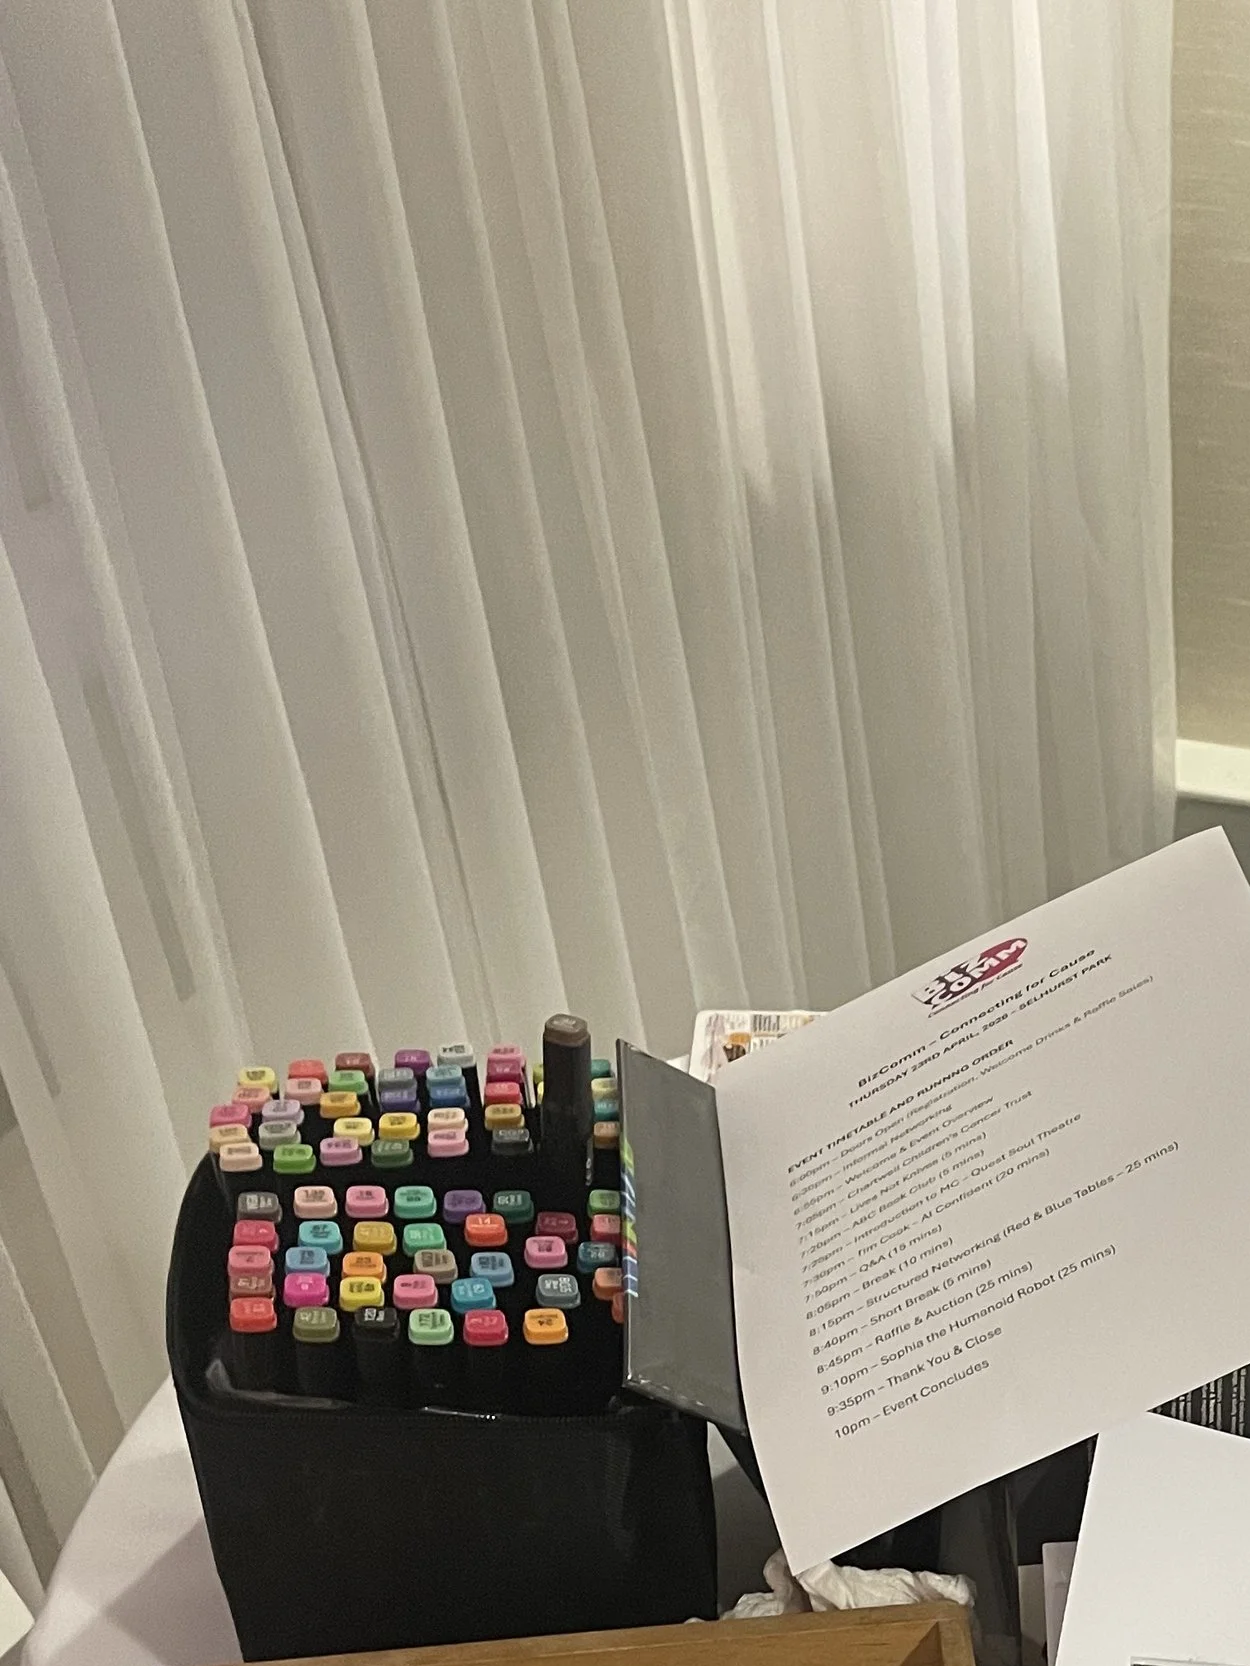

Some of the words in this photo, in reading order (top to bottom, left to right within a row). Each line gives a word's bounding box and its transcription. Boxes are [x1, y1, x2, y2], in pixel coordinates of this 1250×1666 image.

[857, 1044, 926, 1088] BizComm
[938, 989, 1023, 1040] Connecting
[1024, 976, 1045, 992] for
[1048, 949, 1095, 978] Cause
[931, 940, 1026, 1004] COMM
[848, 1067, 908, 1108] THURSDAY
[942, 1031, 980, 1054] APRIL,
[1018, 971, 1078, 1010] SELHURST
[1080, 953, 1112, 975] PARK
[787, 1147, 823, 1174] EVENT
[826, 1110, 887, 1150] TIMETABLE
[888, 1094, 914, 1115] AND
[970, 1038, 1014, 1066] ORDER
[846, 1163, 901, 1199] Chartwell
[959, 1106, 1001, 1134] Cancer
[1002, 1090, 1032, 1109] Trust
[800, 1231, 841, 1259] 7:20pm
[851, 1209, 877, 1229] ABC
[878, 1191, 907, 1213] Book
[908, 1175, 936, 1195] Club
[937, 1166, 950, 1180] (5
[951, 1148, 984, 1171] mins)
[808, 1309, 854, 1337] 8:15pm
[865, 1268, 929, 1308] Structured
[930, 1232, 1002, 1273] Networking
[1002, 1215, 1031, 1238] (Red
[1032, 1210, 1043, 1221] &
[1043, 1196, 1072, 1216] Blue
[1072, 1174, 1114, 1199] Tables
[1124, 1159, 1142, 1174] 25
[1142, 1140, 1179, 1164] mins)
[857, 1241, 878, 1257] Tim
[878, 1223, 910, 1244] Cook
[920, 1209, 933, 1223] AI
[934, 1176, 993, 1214] Confident
[994, 1166, 1014, 1183] (20
[1015, 1147, 1050, 1170] mins)
[804, 1275, 848, 1303] 7:50pm
[858, 1252, 887, 1273] Q&A
[887, 1241, 907, 1259] (15
[908, 1223, 942, 1246] mins)
[805, 1291, 851, 1320] 8:05pm
[861, 1267, 896, 1290] Break
[897, 1254, 917, 1272] (10
[918, 1236, 953, 1260] mins)
[812, 1326, 858, 1356] 8:40pm
[869, 1303, 903, 1326] Short
[904, 1284, 941, 1308] Break
[941, 1276, 955, 1290] (5
[956, 1258, 991, 1282] mins)
[816, 1346, 863, 1374] 8:45pm
[874, 1322, 911, 1345] Raffle
[913, 1315, 923, 1326] &
[924, 1291, 974, 1320] Auction
[974, 1278, 996, 1297] (25
[996, 1260, 1033, 1284] mins)
[820, 1366, 869, 1395] 9:10pm
[879, 1339, 924, 1366] Sophia
[925, 1327, 947, 1343] the
[947, 1292, 1015, 1332] Humanoid
[1016, 1273, 1056, 1299] Robot
[1056, 1261, 1078, 1280] (25
[1079, 1243, 1116, 1268] mins)
[826, 1388, 876, 1417] 9:35pm
[884, 1362, 926, 1387] Thank
[925, 1351, 951, 1367] You
[952, 1344, 963, 1356] &
[964, 1326, 1002, 1349] Close
[834, 1416, 871, 1438] 10pm
[881, 1392, 919, 1416] Event
[919, 1359, 989, 1398] Concludes
